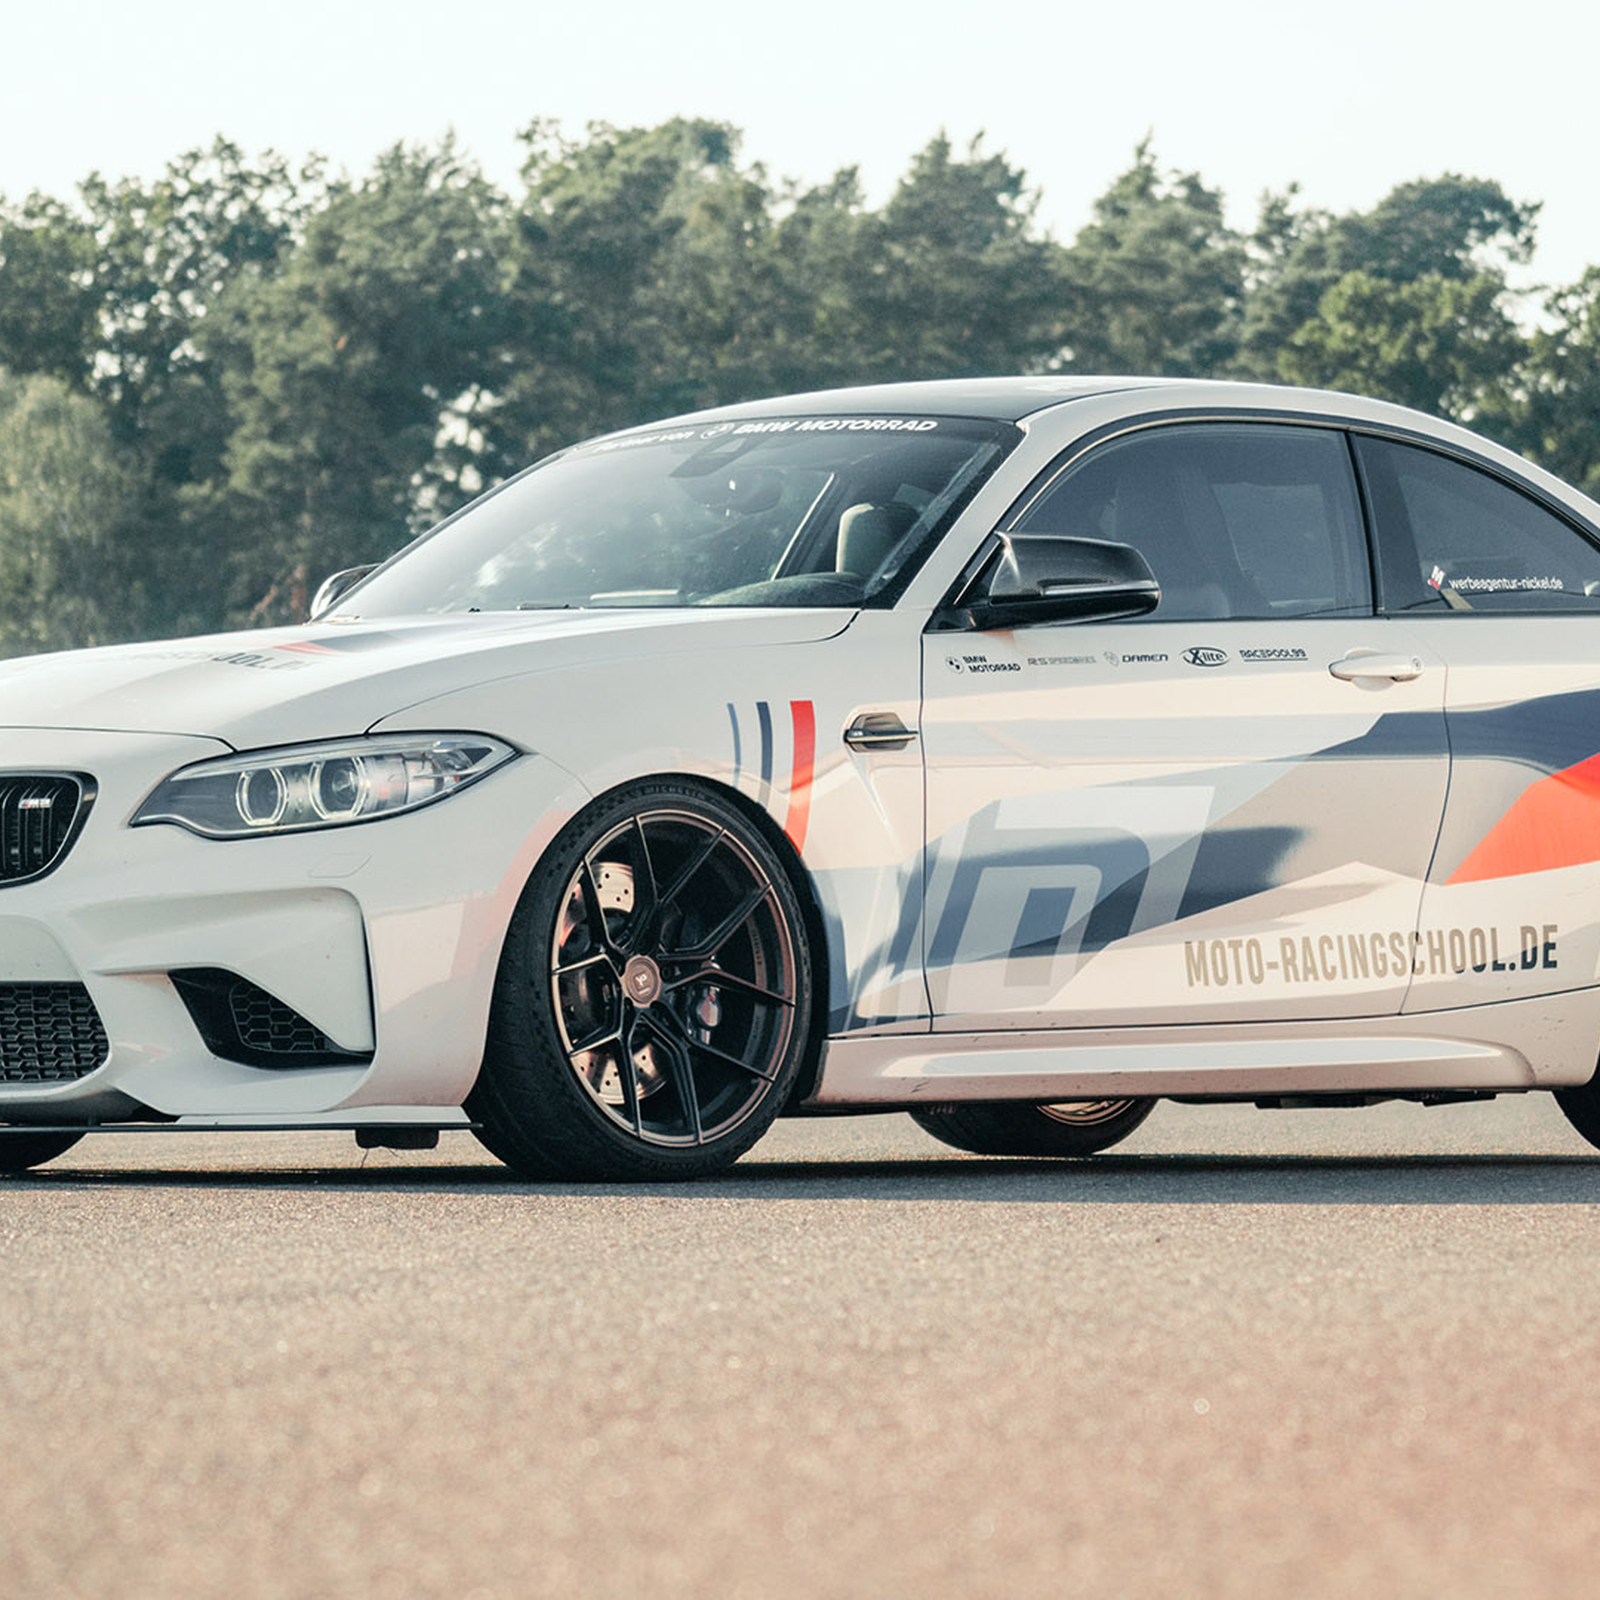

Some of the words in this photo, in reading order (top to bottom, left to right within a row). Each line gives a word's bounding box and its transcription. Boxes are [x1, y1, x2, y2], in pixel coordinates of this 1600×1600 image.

[732, 421, 800, 434] BMW
[795, 419, 939, 432] MOTORRAD
[1448, 576, 1564, 592] werbeagentur-nickel.de
[962, 655, 988, 664] BMW
[1122, 654, 1168, 663] DAMEN
[968, 663, 1021, 673] MOTORRAD
[1184, 924, 1559, 987] MOTO-RACINGSCHOOL.DE
